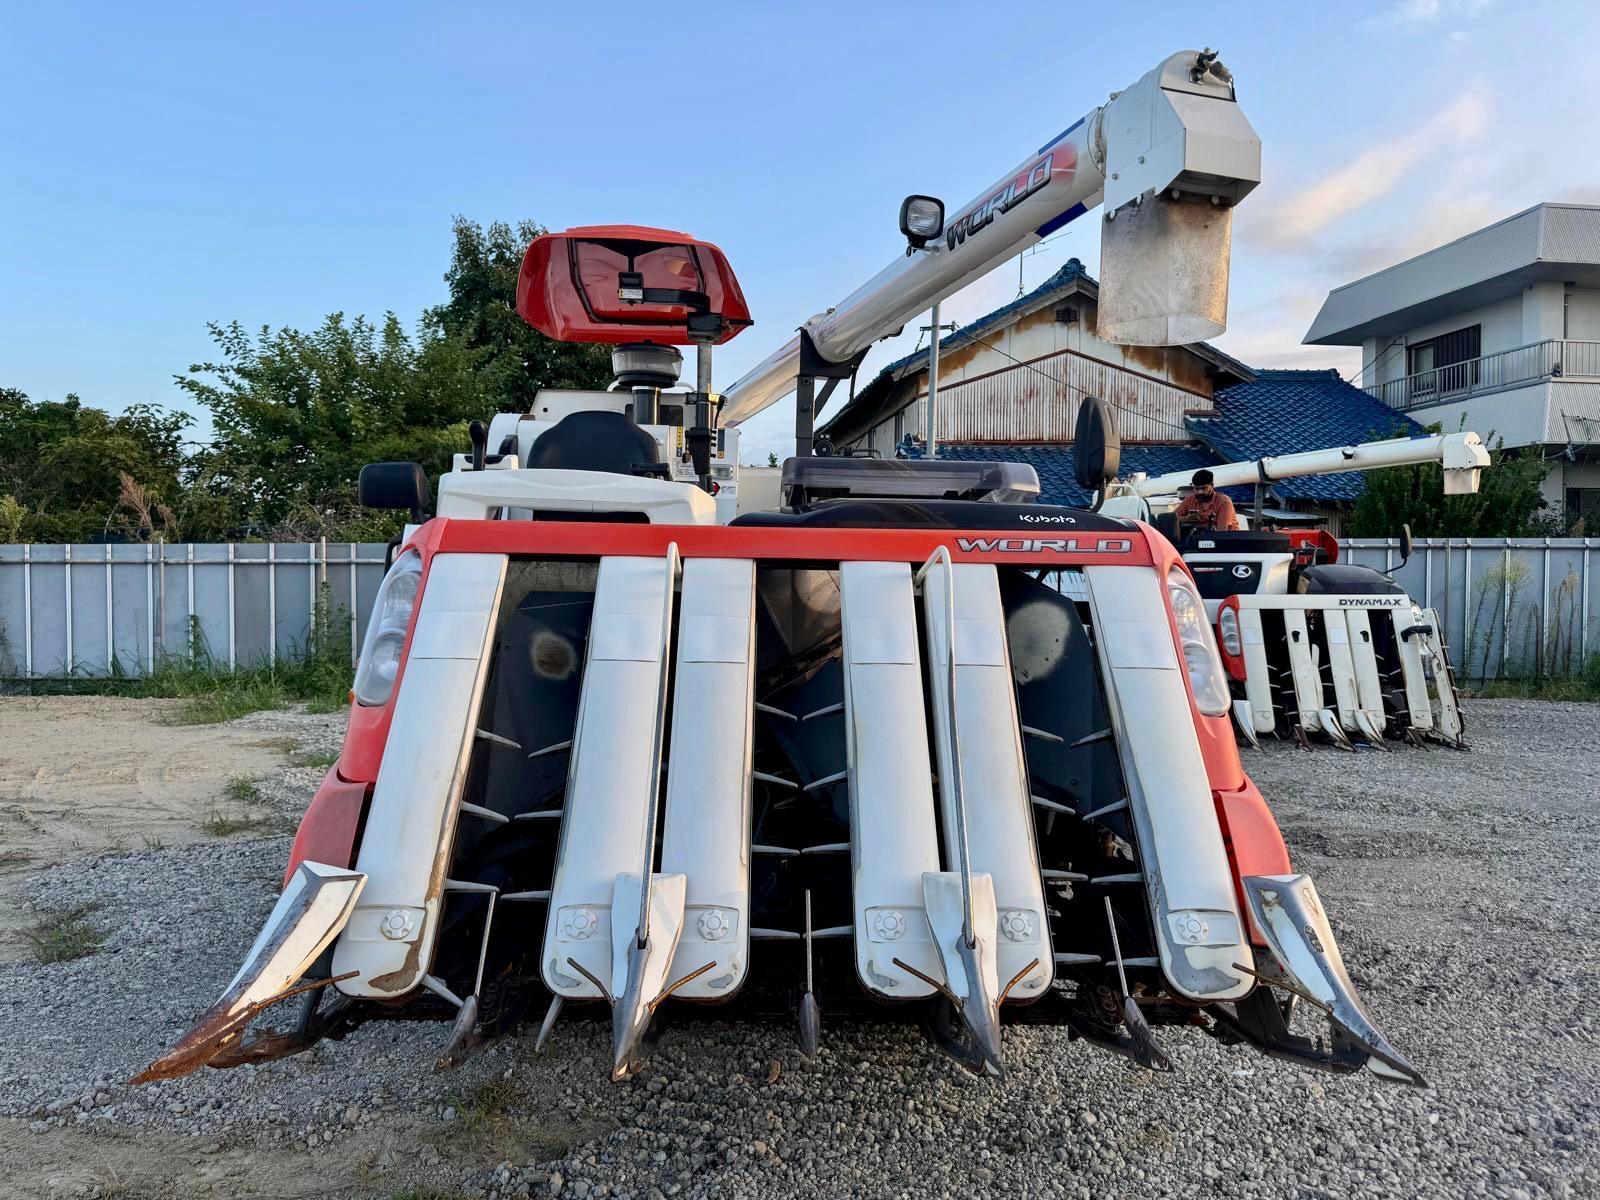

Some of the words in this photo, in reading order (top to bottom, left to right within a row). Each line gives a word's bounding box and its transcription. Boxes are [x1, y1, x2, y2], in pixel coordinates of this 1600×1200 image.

[947, 153, 1053, 251] WORLD
[1018, 514, 1076, 524] Kubota
[956, 537, 1132, 553] WORLD
